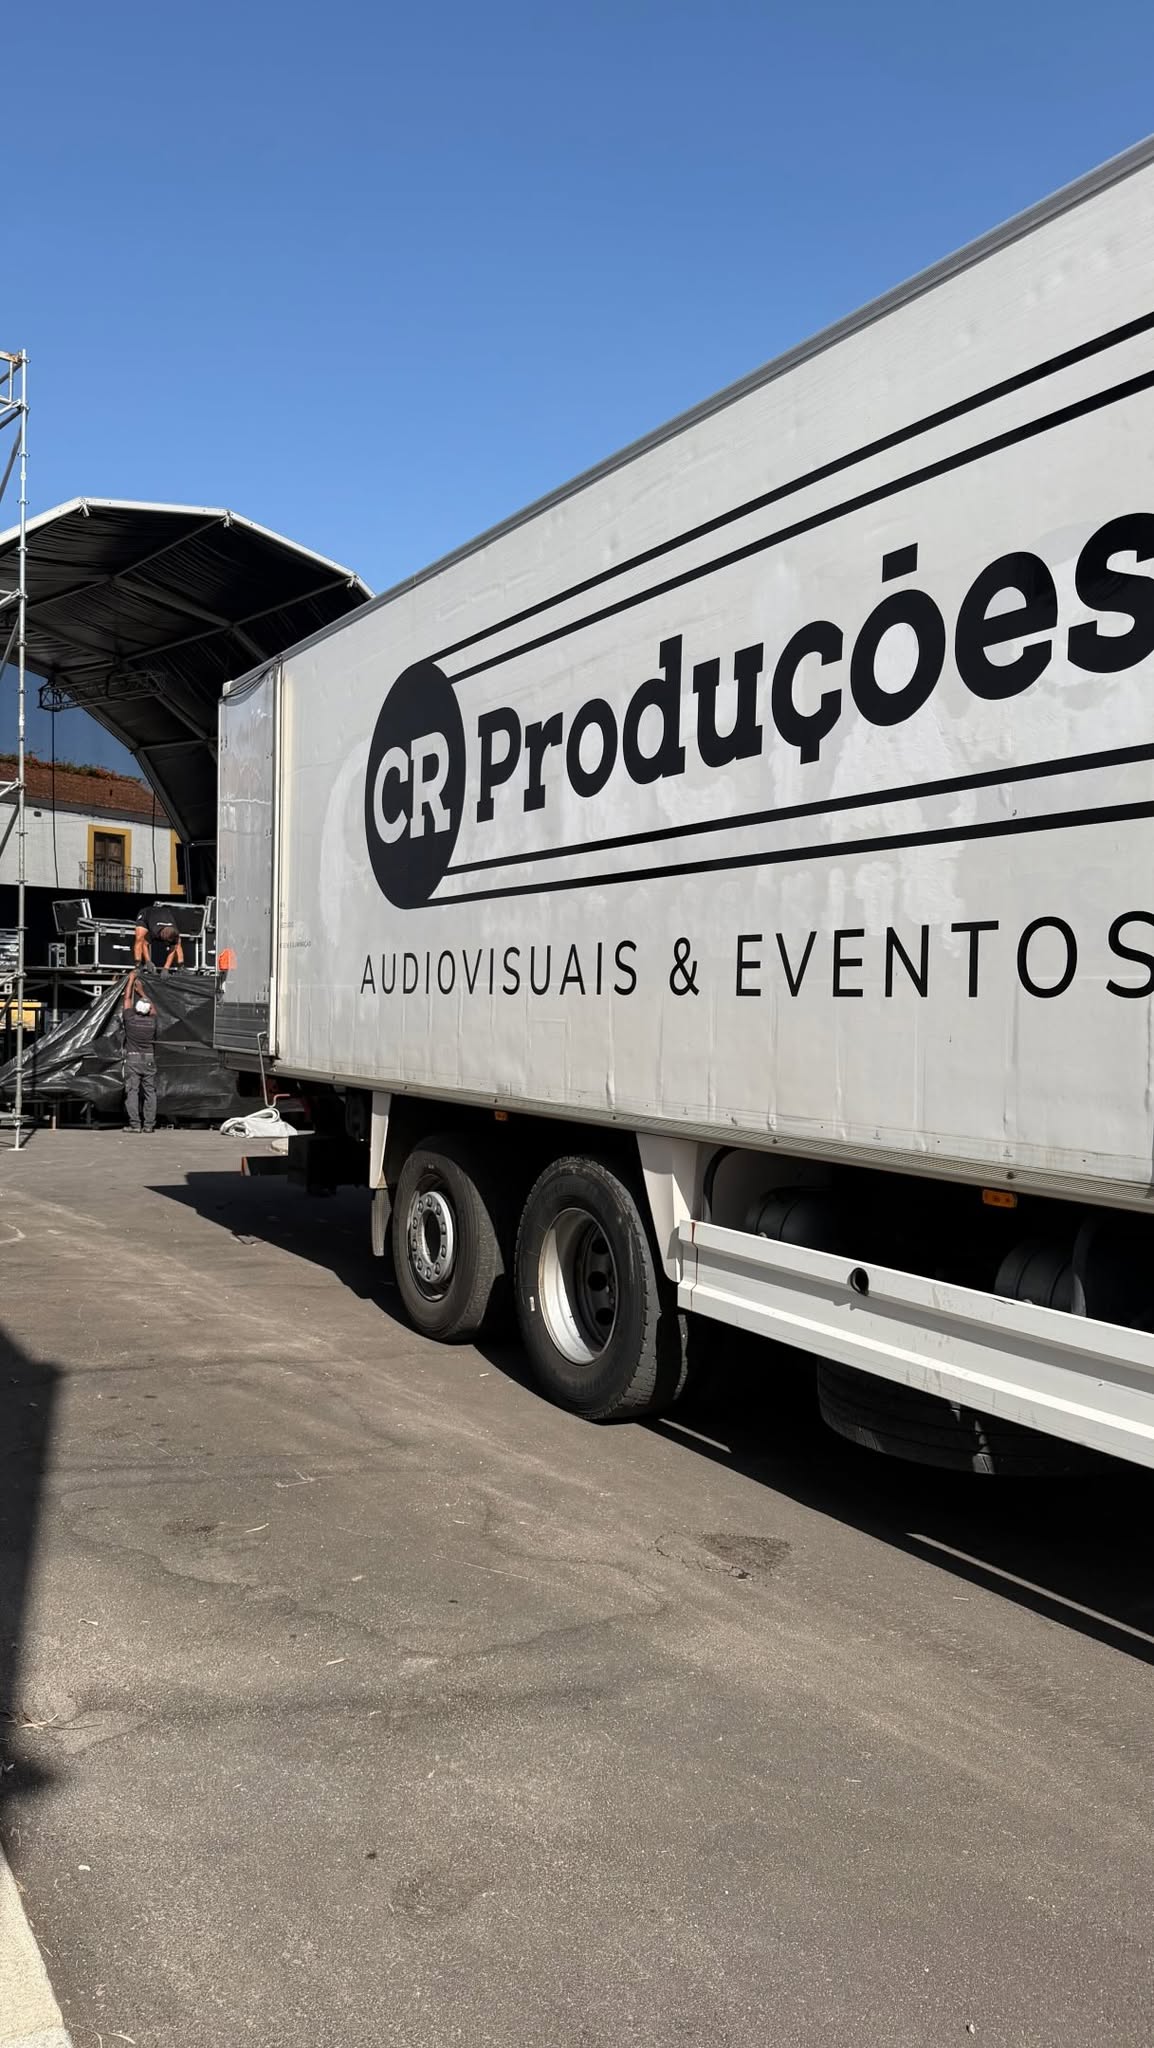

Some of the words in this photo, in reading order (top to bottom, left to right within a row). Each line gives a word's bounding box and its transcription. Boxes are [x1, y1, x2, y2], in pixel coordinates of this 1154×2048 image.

[373, 731, 451, 844] CR
[476, 512, 1154, 823] Produções
[360, 940, 638, 996] AUDIOVISUAIS
[669, 937, 700, 996] &
[735, 910, 1154, 999] EVENTOS
